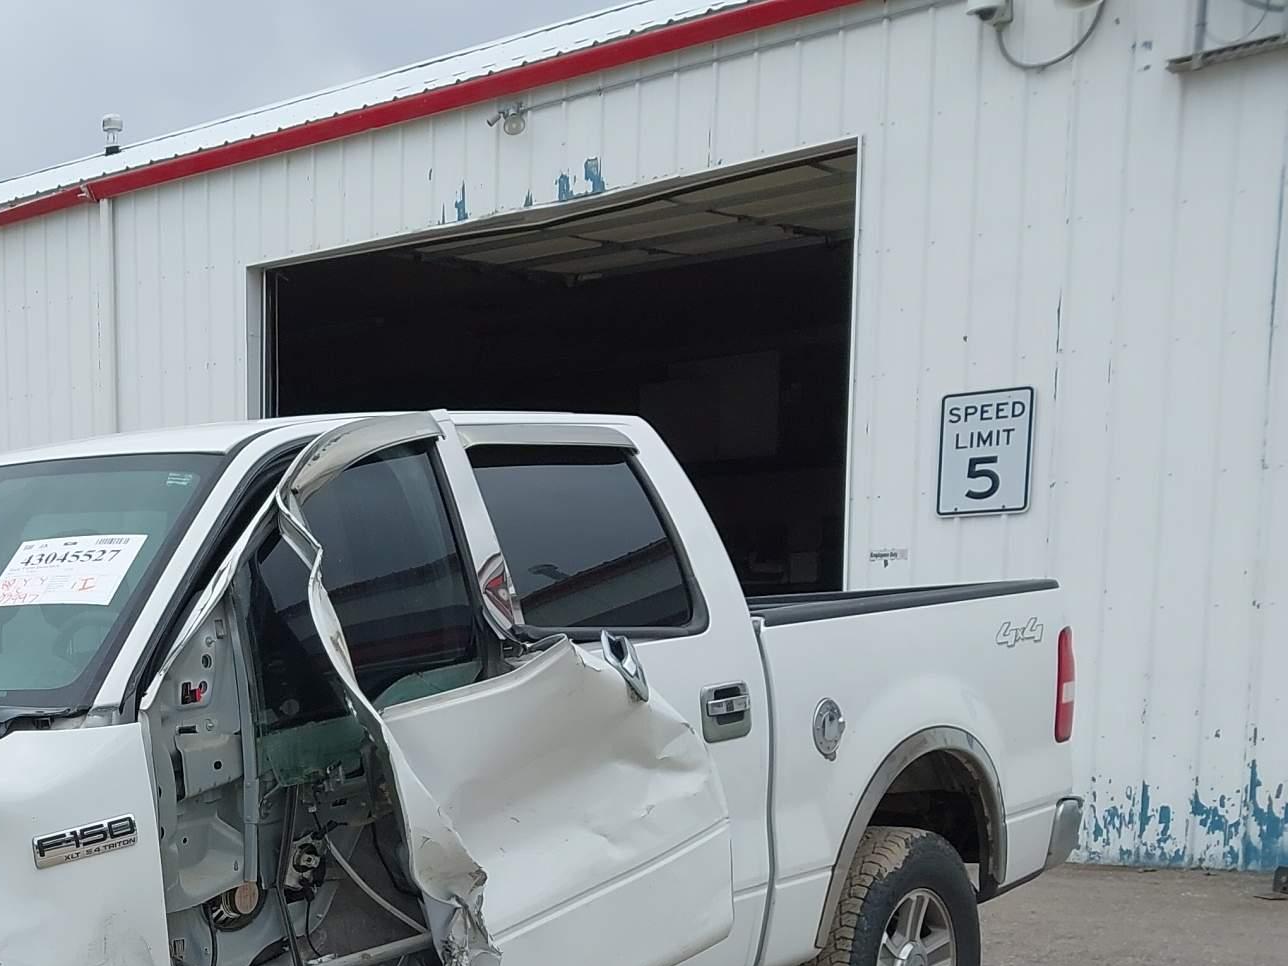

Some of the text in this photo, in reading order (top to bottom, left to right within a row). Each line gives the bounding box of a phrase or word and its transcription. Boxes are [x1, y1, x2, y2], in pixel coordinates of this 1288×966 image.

[948, 401, 1026, 424] SPEED
[955, 428, 1015, 450] LIMIT
[965, 455, 1001, 500] 5
[20, 549, 122, 567] 43045527
[996, 617, 1044, 648] 4x4
[64, 852, 81, 862] XLT
[103, 837, 136, 851] TRITON
